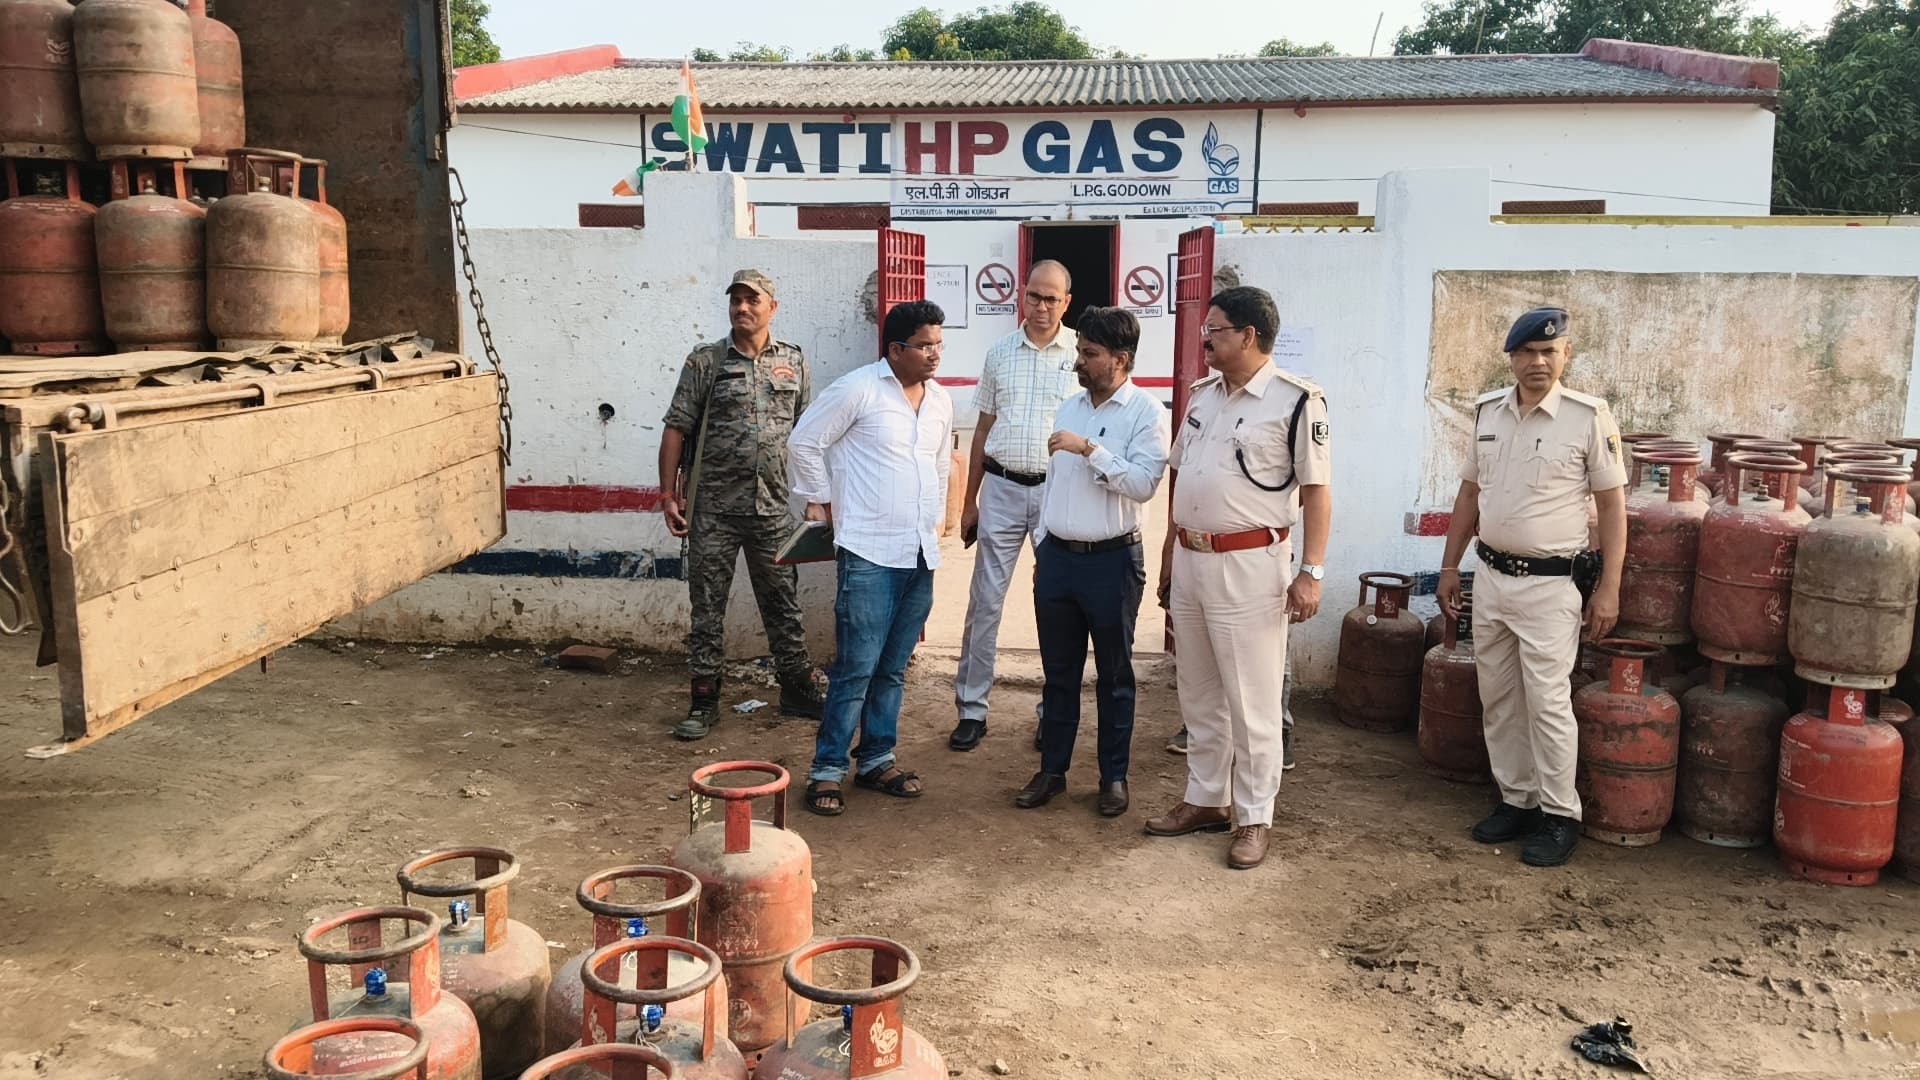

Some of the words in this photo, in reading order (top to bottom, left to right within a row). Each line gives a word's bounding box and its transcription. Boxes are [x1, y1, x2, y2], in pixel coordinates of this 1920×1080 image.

[651, 122, 891, 174] SWATI
[904, 121, 1009, 175] HP
[1022, 117, 1186, 173] GAS
[1208, 180, 1239, 193] GAS
